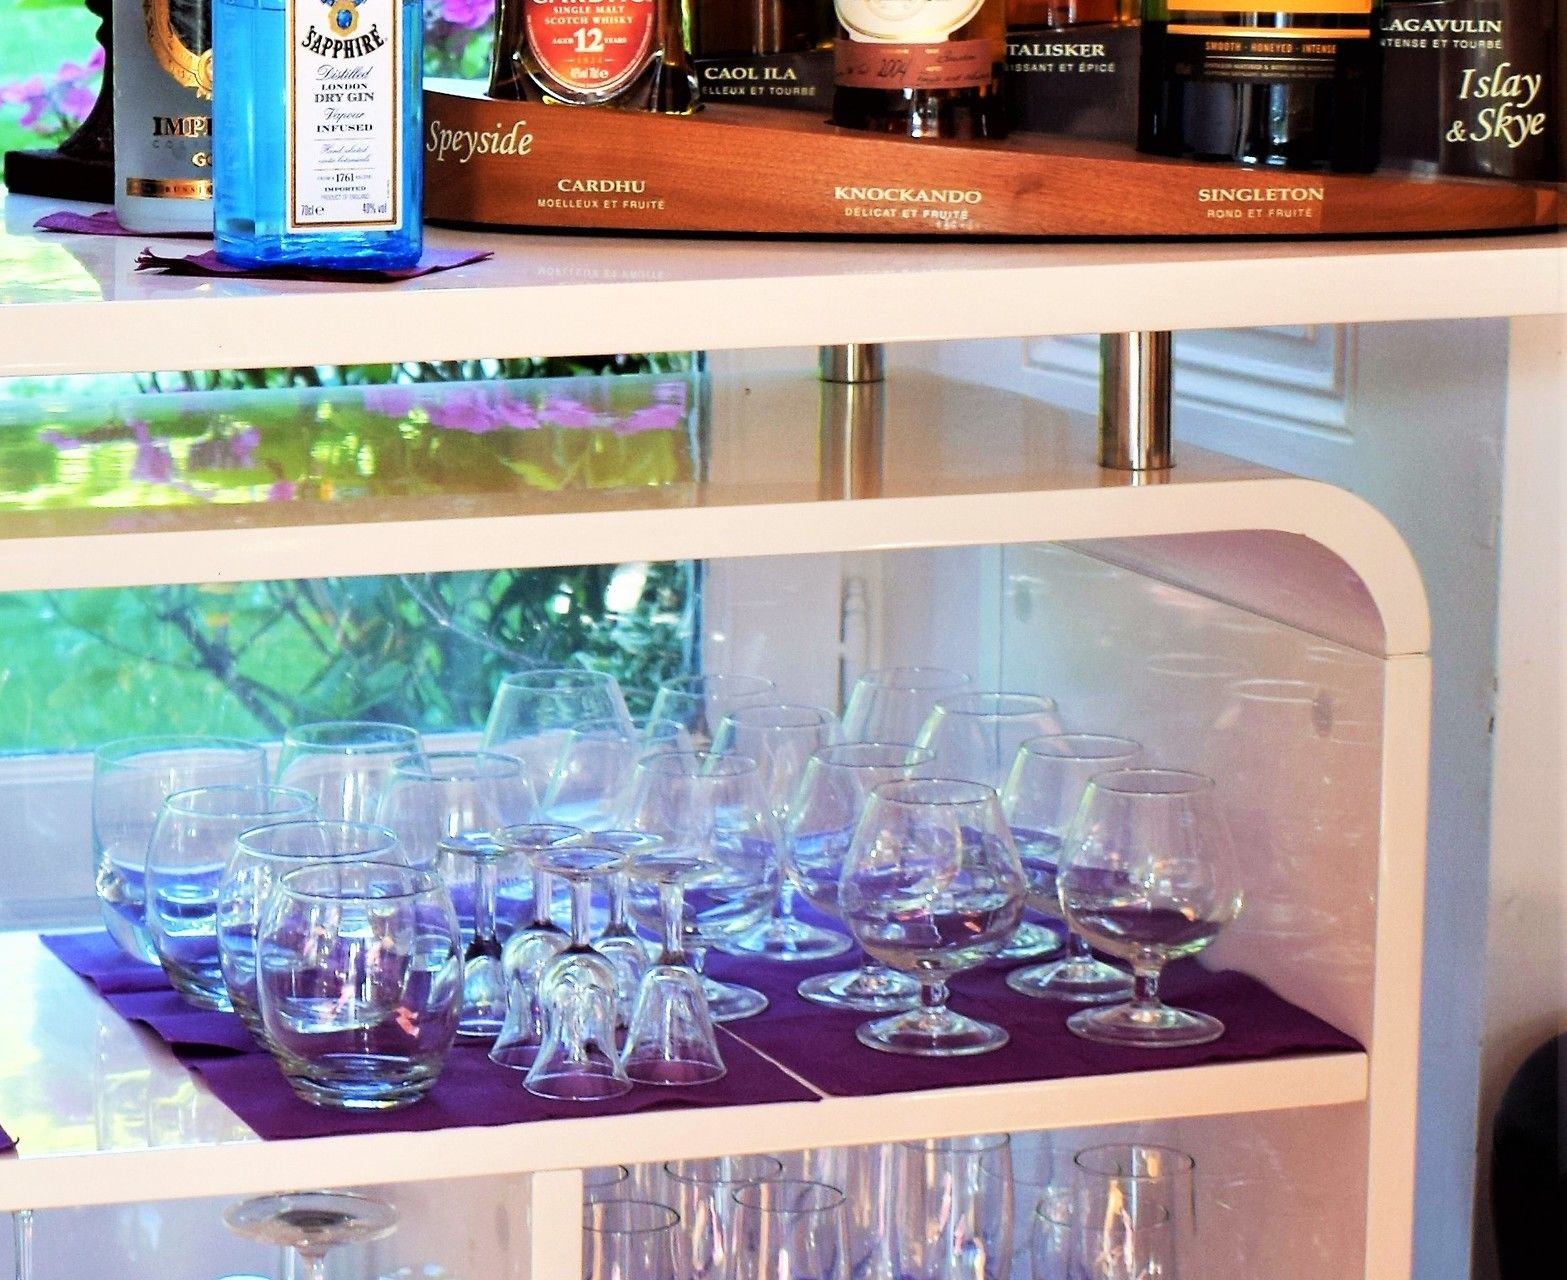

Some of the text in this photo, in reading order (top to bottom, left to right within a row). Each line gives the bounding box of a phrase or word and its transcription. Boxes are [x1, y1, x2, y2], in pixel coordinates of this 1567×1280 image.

[595, 5, 625, 13] MALT
[592, 16, 634, 24] WHISKY
[301, 24, 385, 59] SAPPHIRE
[573, 27, 605, 52] 12
[1432, 39, 1448, 48] ET
[1007, 44, 1105, 57] TALISKER
[1206, 41, 1337, 54] SMOOTH HONEYED INTENSE
[316, 64, 374, 81] Distilled
[704, 67, 797, 80] CAOL ILA
[1059, 63, 1073, 72] ET
[322, 83, 368, 91] LONDON
[750, 86, 764, 95] ET
[1459, 62, 1542, 108] Islay
[314, 92, 375, 103] DRY GIN
[323, 107, 365, 123] Vapour
[317, 124, 373, 133] INFUSED
[1446, 102, 1546, 148] & Skye
[426, 119, 534, 163] Speyside
[336, 173, 354, 182] 1761
[557, 179, 646, 193] CARDHU
[834, 187, 982, 204] KNOCKANDO
[1198, 188, 1325, 202] SINGLETON
[537, 198, 598, 208] MOELLEUX
[604, 200, 618, 209] ET
[902, 209, 918, 218] ET
[1207, 209, 1242, 218] ROND
[1247, 209, 1262, 218] ET
